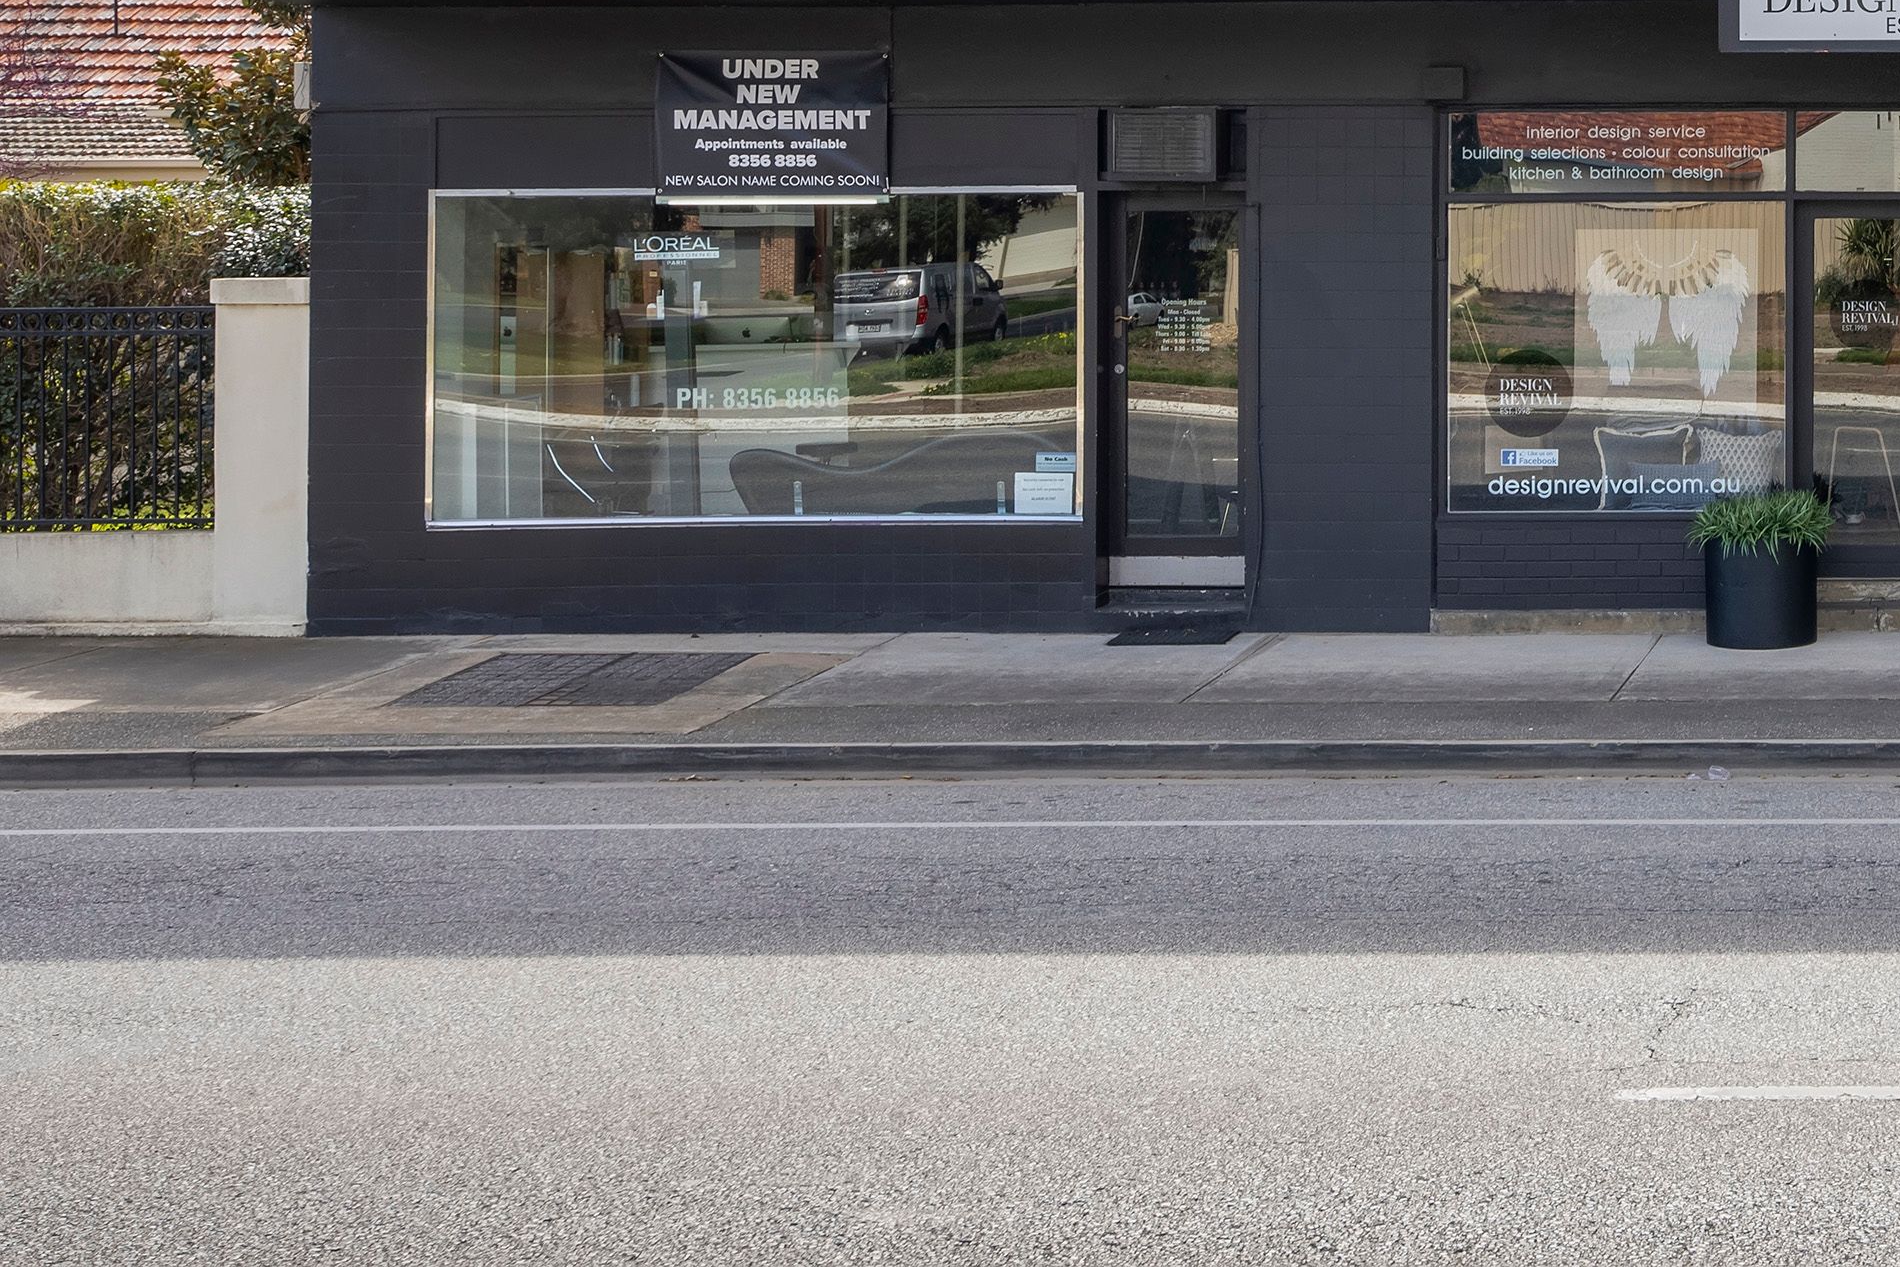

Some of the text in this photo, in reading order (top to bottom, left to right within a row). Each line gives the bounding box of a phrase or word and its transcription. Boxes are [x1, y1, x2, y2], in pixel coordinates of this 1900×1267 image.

[722, 59, 820, 79] UNDER
[736, 84, 801, 104] NEW
[674, 110, 871, 130] MANAGEMENT
[1526, 126, 1706, 141] interior design service
[694, 138, 847, 151] Appointments available
[728, 154, 817, 168] 8356 8856
[1462, 146, 1770, 162] building selections colour consultation
[665, 175, 880, 186] NEW SALON NAME COMING SOON!
[1509, 166, 1723, 182] kitchen & bathroom design
[1162, 297, 1187, 307] Opening
[1842, 301, 1887, 312] DESIGN
[1500, 378, 1553, 391] DESIGN
[676, 387, 840, 409] PH: 8356 8856
[1500, 393, 1561, 405] REVIVAL
[1488, 475, 1740, 498] designrevival.com.au
